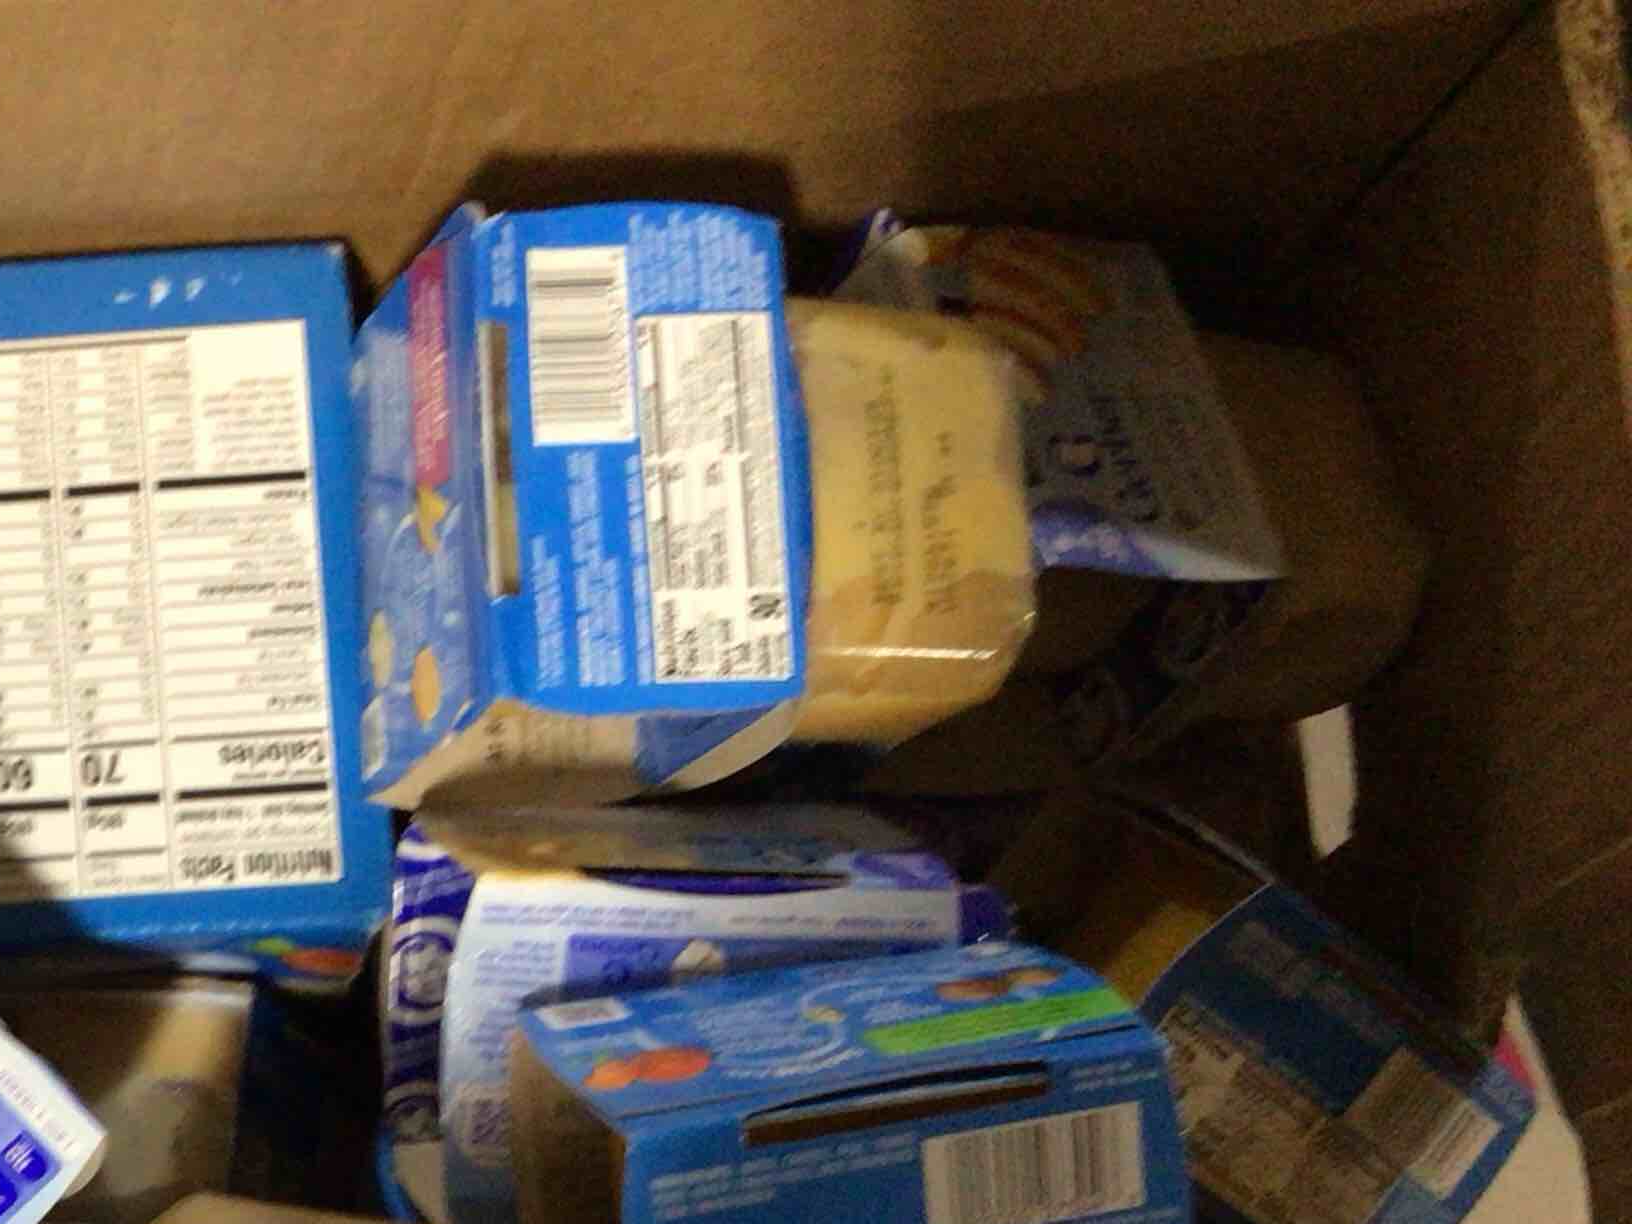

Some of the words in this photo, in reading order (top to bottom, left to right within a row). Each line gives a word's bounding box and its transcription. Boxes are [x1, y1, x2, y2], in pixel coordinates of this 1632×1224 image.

[80, 751, 125, 787] 70
[217, 739, 326, 769] Calories
[179, 854, 236, 884] Facts
[245, 847, 333, 878] Nutrition
